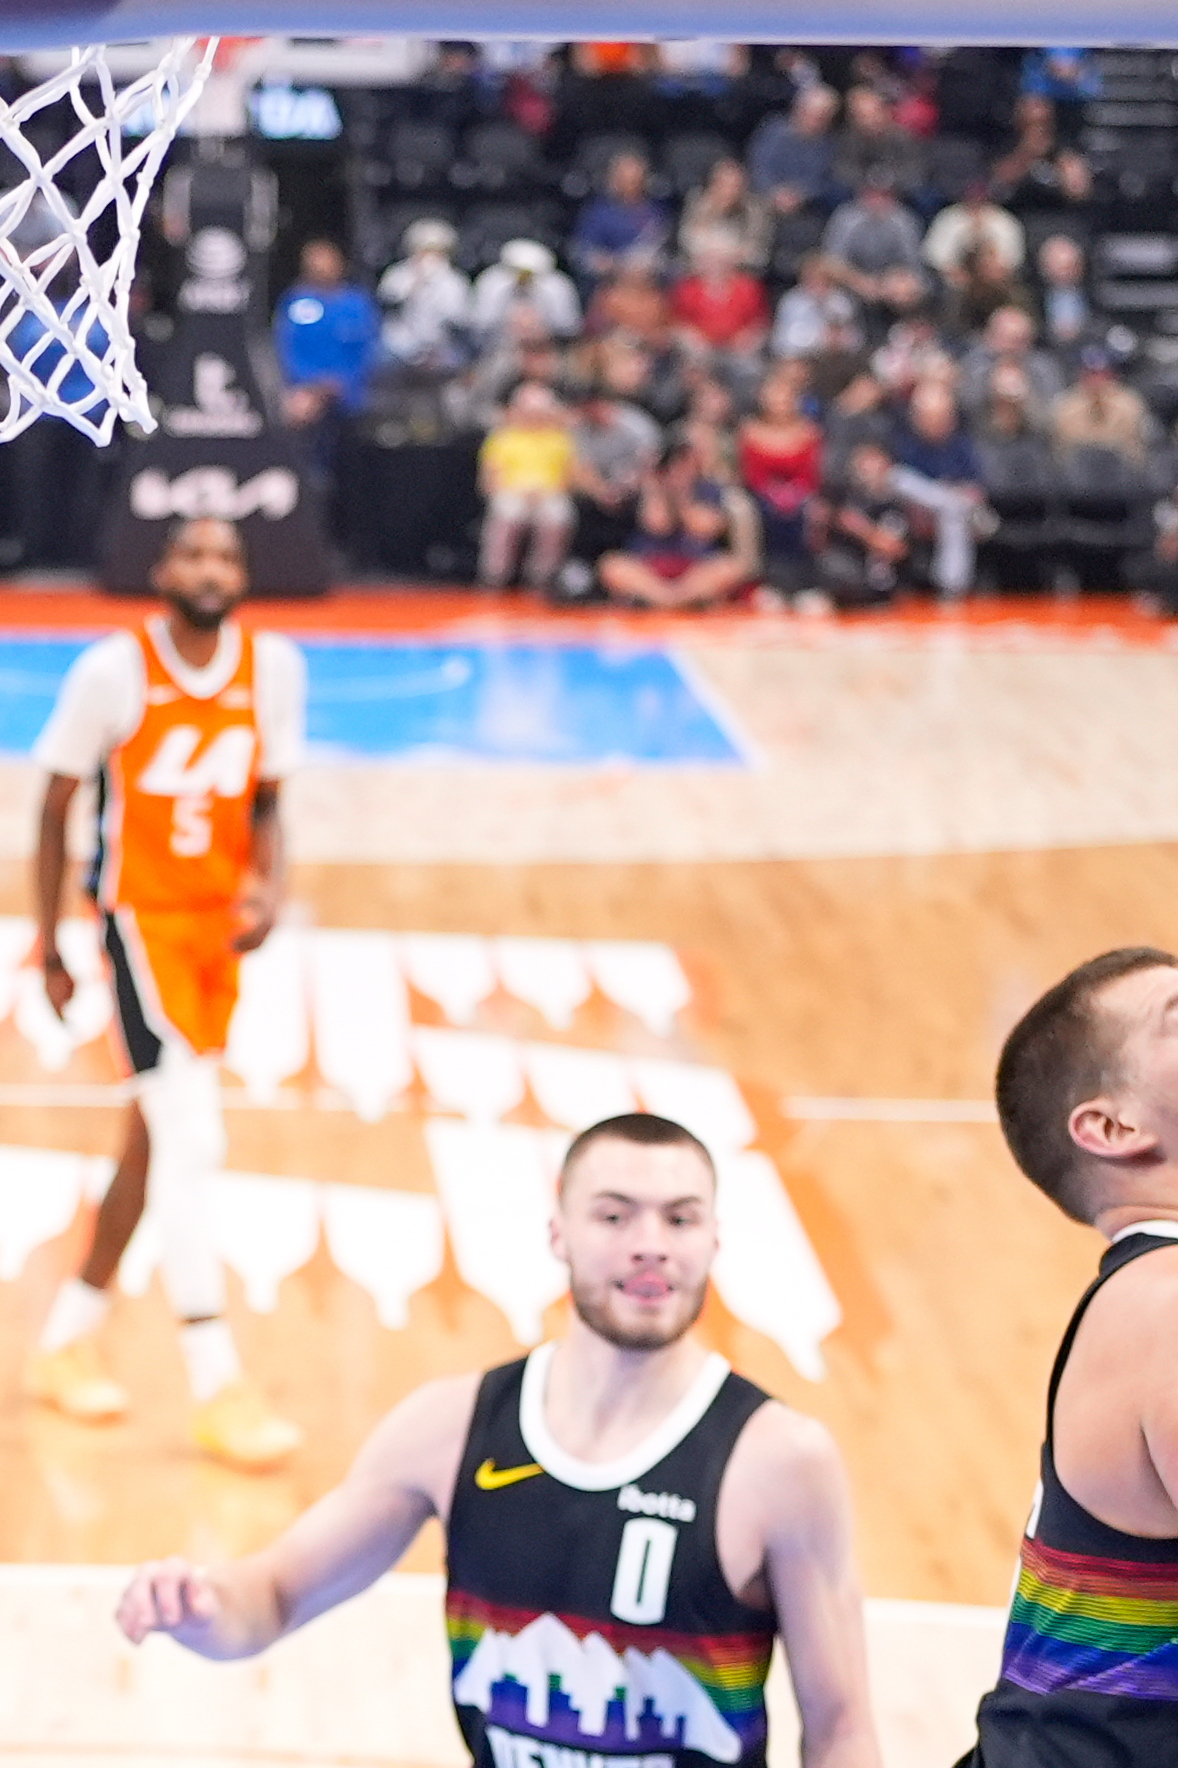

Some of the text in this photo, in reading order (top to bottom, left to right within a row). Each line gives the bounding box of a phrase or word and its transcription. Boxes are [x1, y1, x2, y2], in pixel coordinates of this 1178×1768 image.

[137, 724, 257, 797] LA
[168, 796, 214, 858] 5
[610, 1515, 679, 1626] 0
